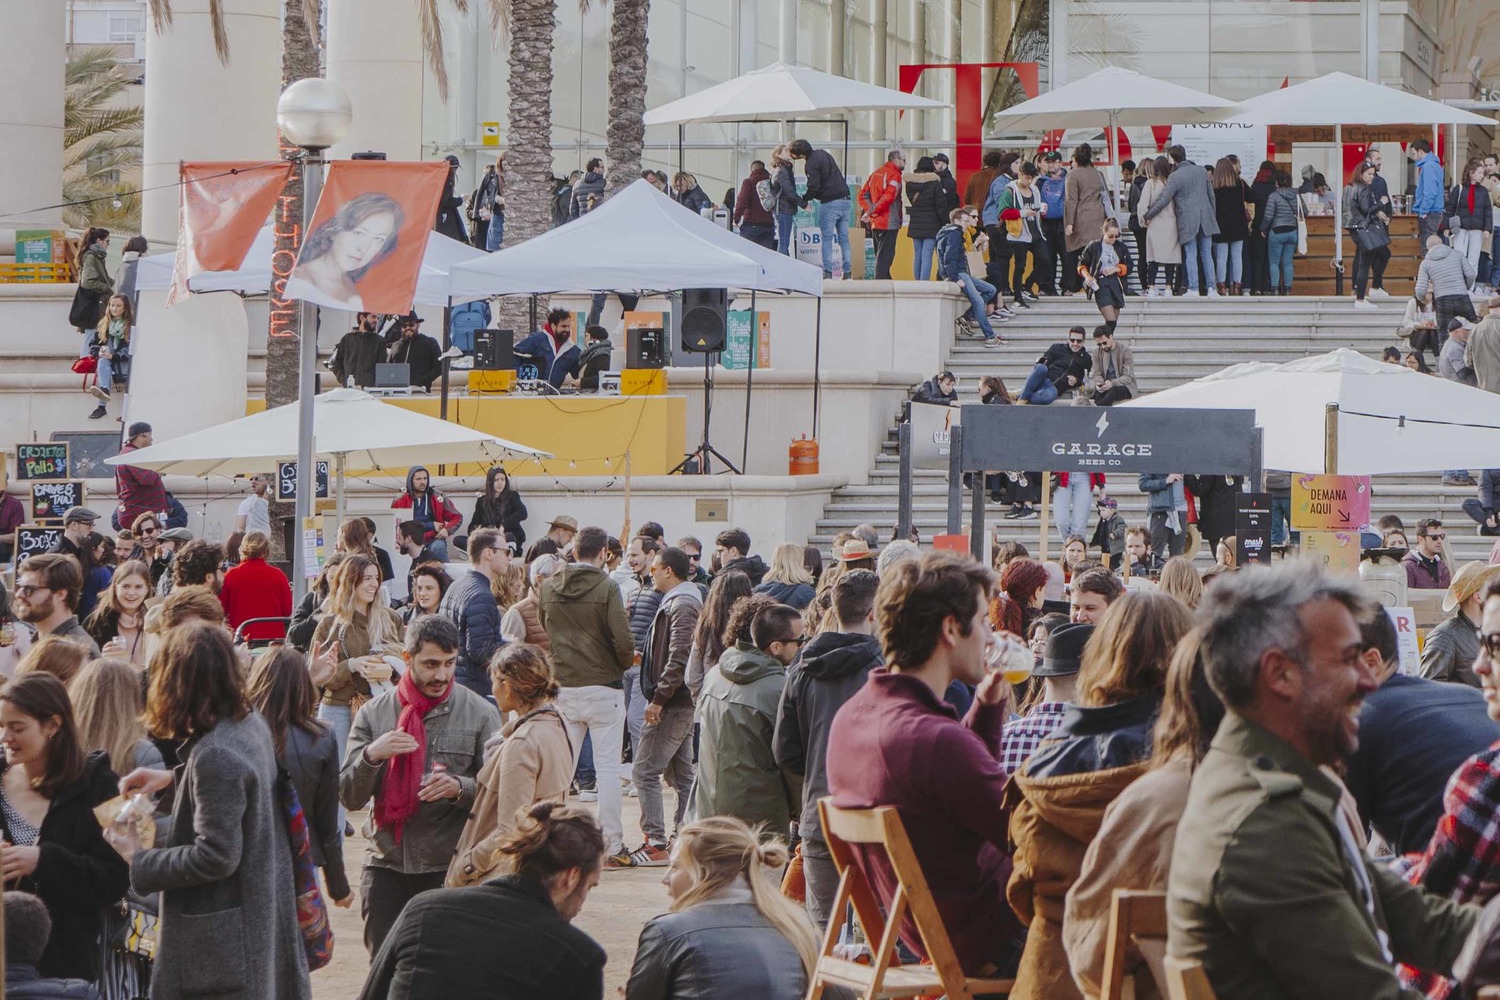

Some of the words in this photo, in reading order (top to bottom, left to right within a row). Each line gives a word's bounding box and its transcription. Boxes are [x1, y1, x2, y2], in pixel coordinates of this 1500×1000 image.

[1052, 442, 1152, 457] GARAGE
[1078, 458, 1105, 466] BEER
[1108, 459, 1123, 467] CO.
[1310, 489, 1348, 501] DEMANA
[1310, 501, 1332, 515] AQUÍ
